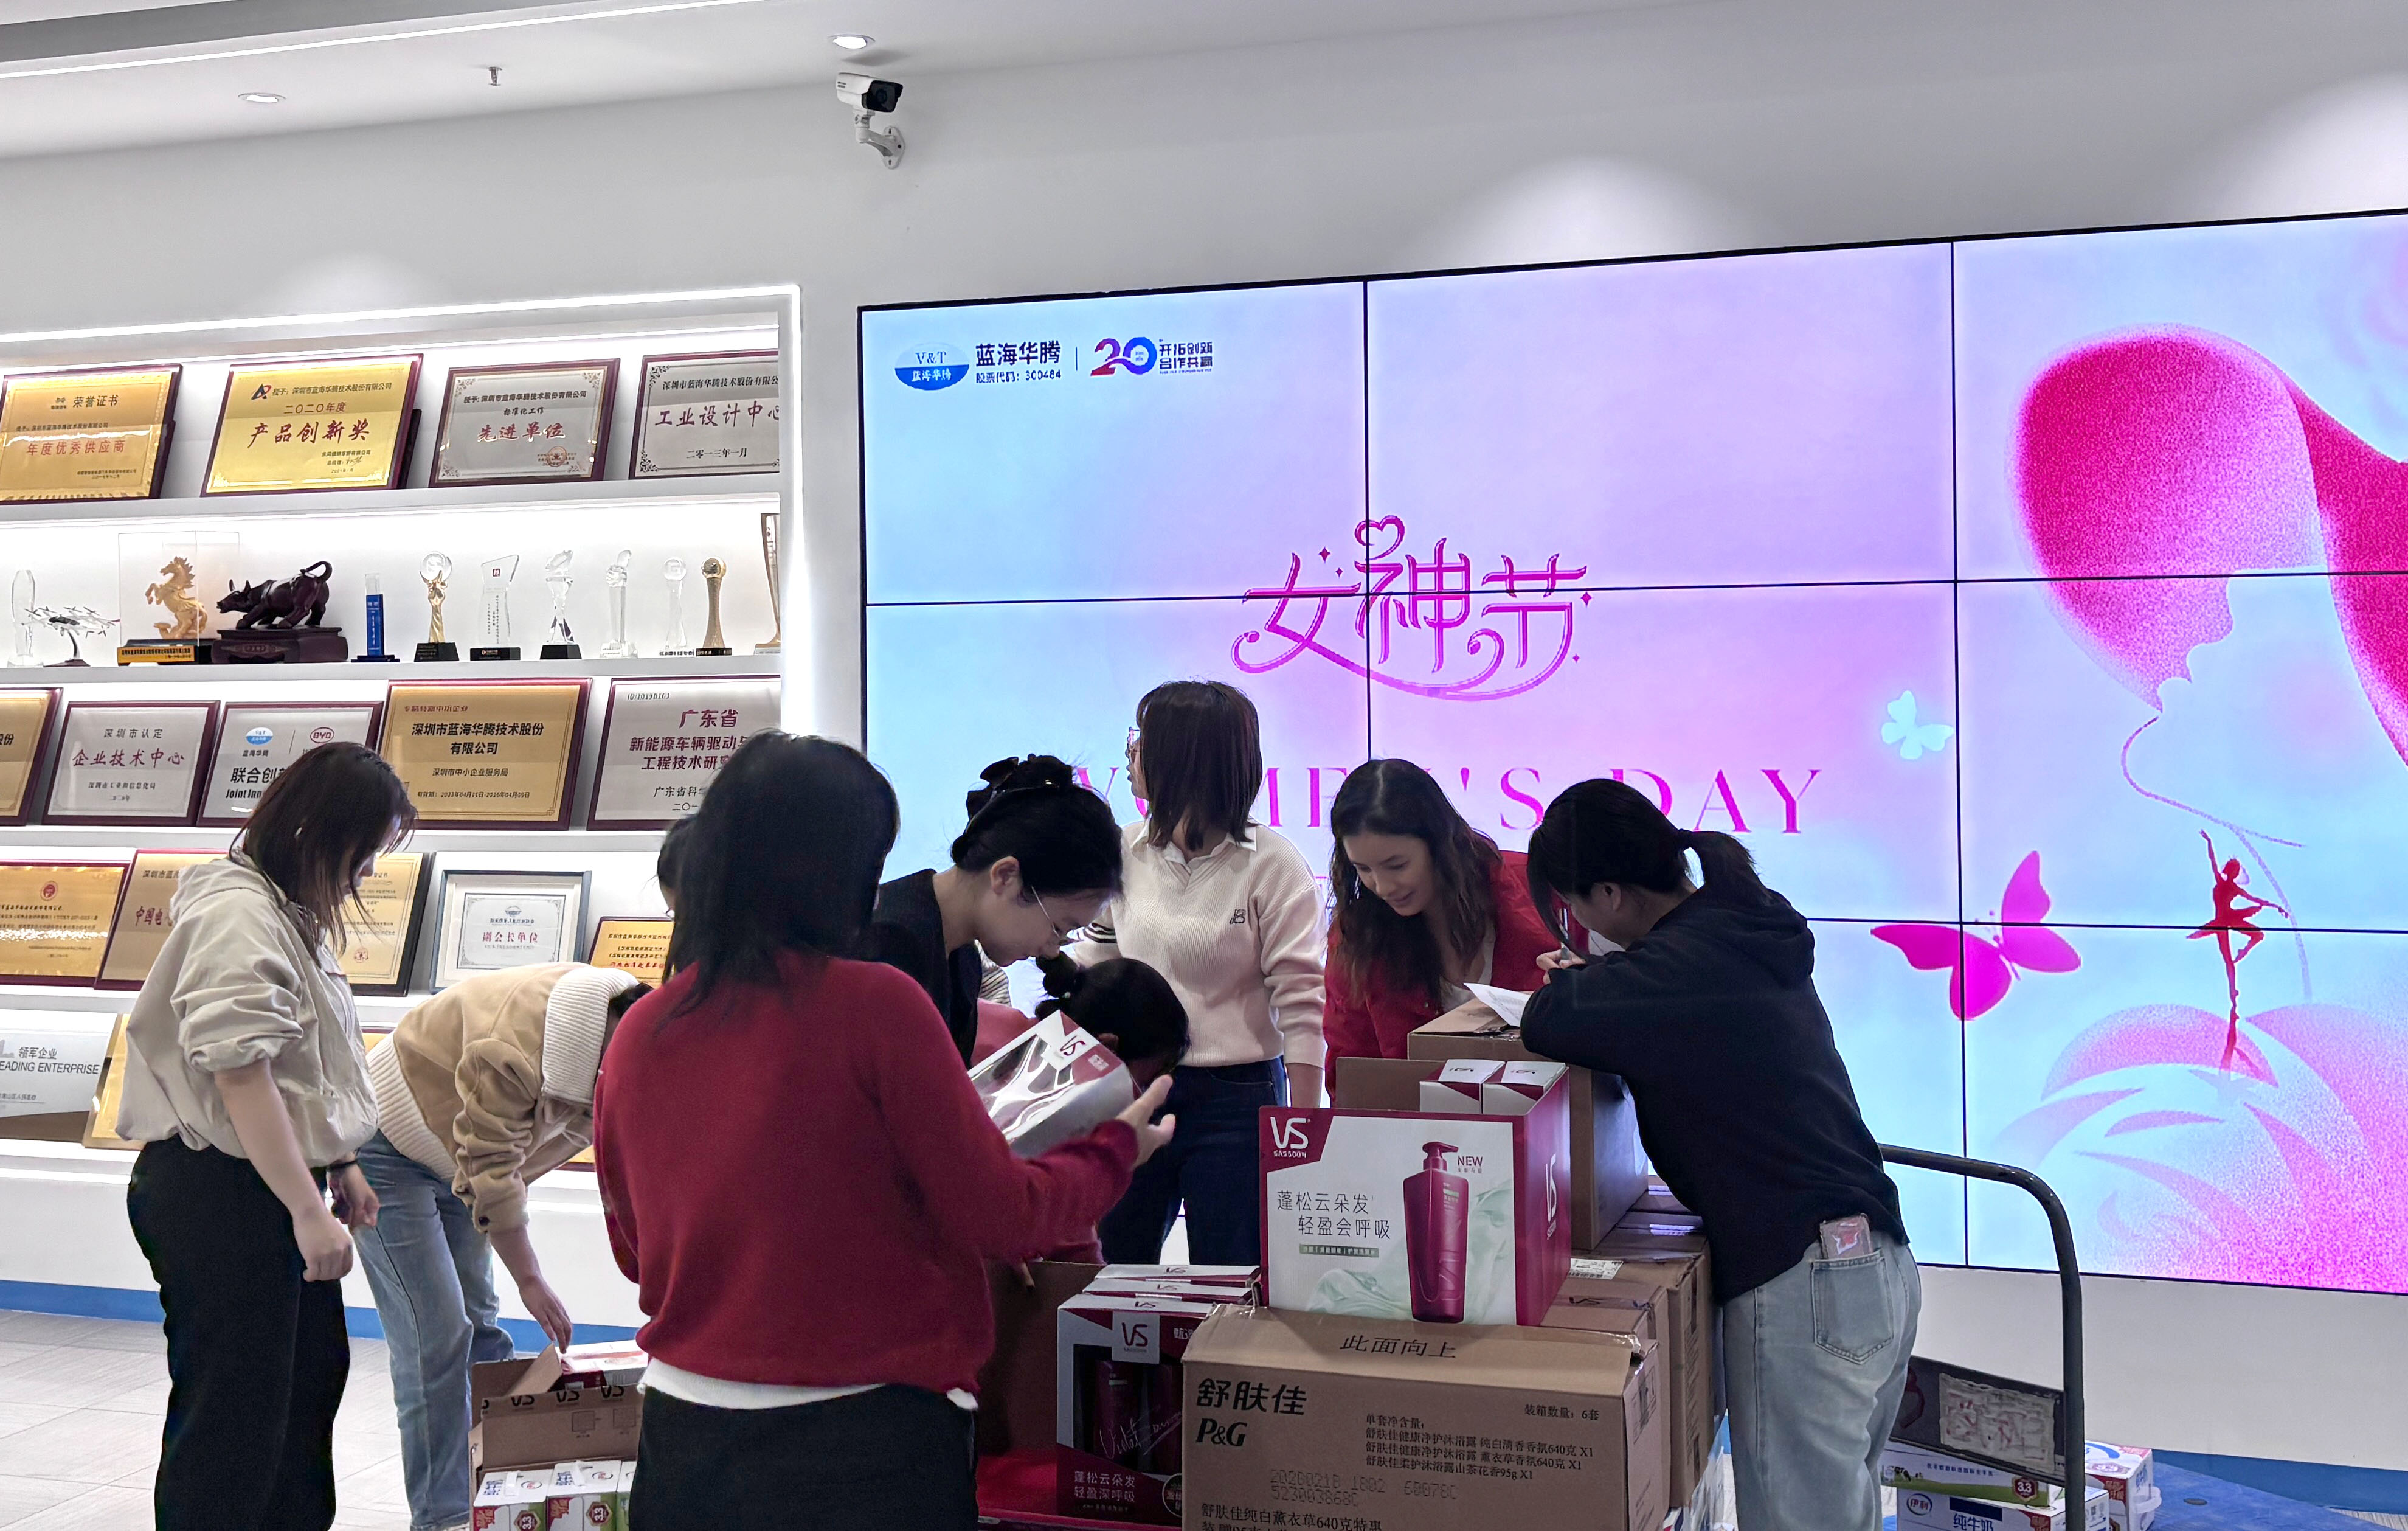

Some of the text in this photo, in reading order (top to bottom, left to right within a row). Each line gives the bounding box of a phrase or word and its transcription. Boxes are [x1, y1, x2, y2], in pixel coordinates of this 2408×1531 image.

[915, 351, 947, 364] V&T
[975, 340, 1061, 367] 蓝海华腾
[73, 395, 119, 408] 荣誉证书
[247, 418, 370, 448] 产品创新奖
[477, 421, 566, 442] 先进单位
[26, 440, 125, 456] 年度优秀供应商
[686, 448, 747, 459] 二零一三年一月
[1231, 515, 1587, 701] 女神节
[679, 709, 739, 729] 广东省
[104, 728, 163, 738] 深圳市认定
[412, 723, 544, 736] 深圳市蓝海华腾技术股份
[0, 733, 15, 746] 份
[451, 742, 498, 755] 有限公司
[72, 748, 184, 769] 企业技术中心
[230, 767, 287, 784] 联合创
[226, 789, 247, 799] Joint
[482, 931, 538, 943] 副会长单位
[19, 1047, 57, 1060] 领军企业
[38, 1062, 100, 1075] ENTERPRISE
[1270, 1117, 1309, 1149] VS
[1458, 1156, 1483, 1167] NEW
[1298, 1215, 1390, 1240] 轻盈会呼吸
[1122, 1322, 1147, 1347] VS
[1340, 1335, 1456, 1358] 此面向上
[1196, 1378, 1307, 1415] 舒肤佳
[1195, 1418, 1248, 1447] P&G
[1074, 1471, 1135, 1488] 蓬松云朵发
[1911, 1498, 1928, 1510] 伊利
[1953, 1513, 1994, 1531] 纯牛奶
